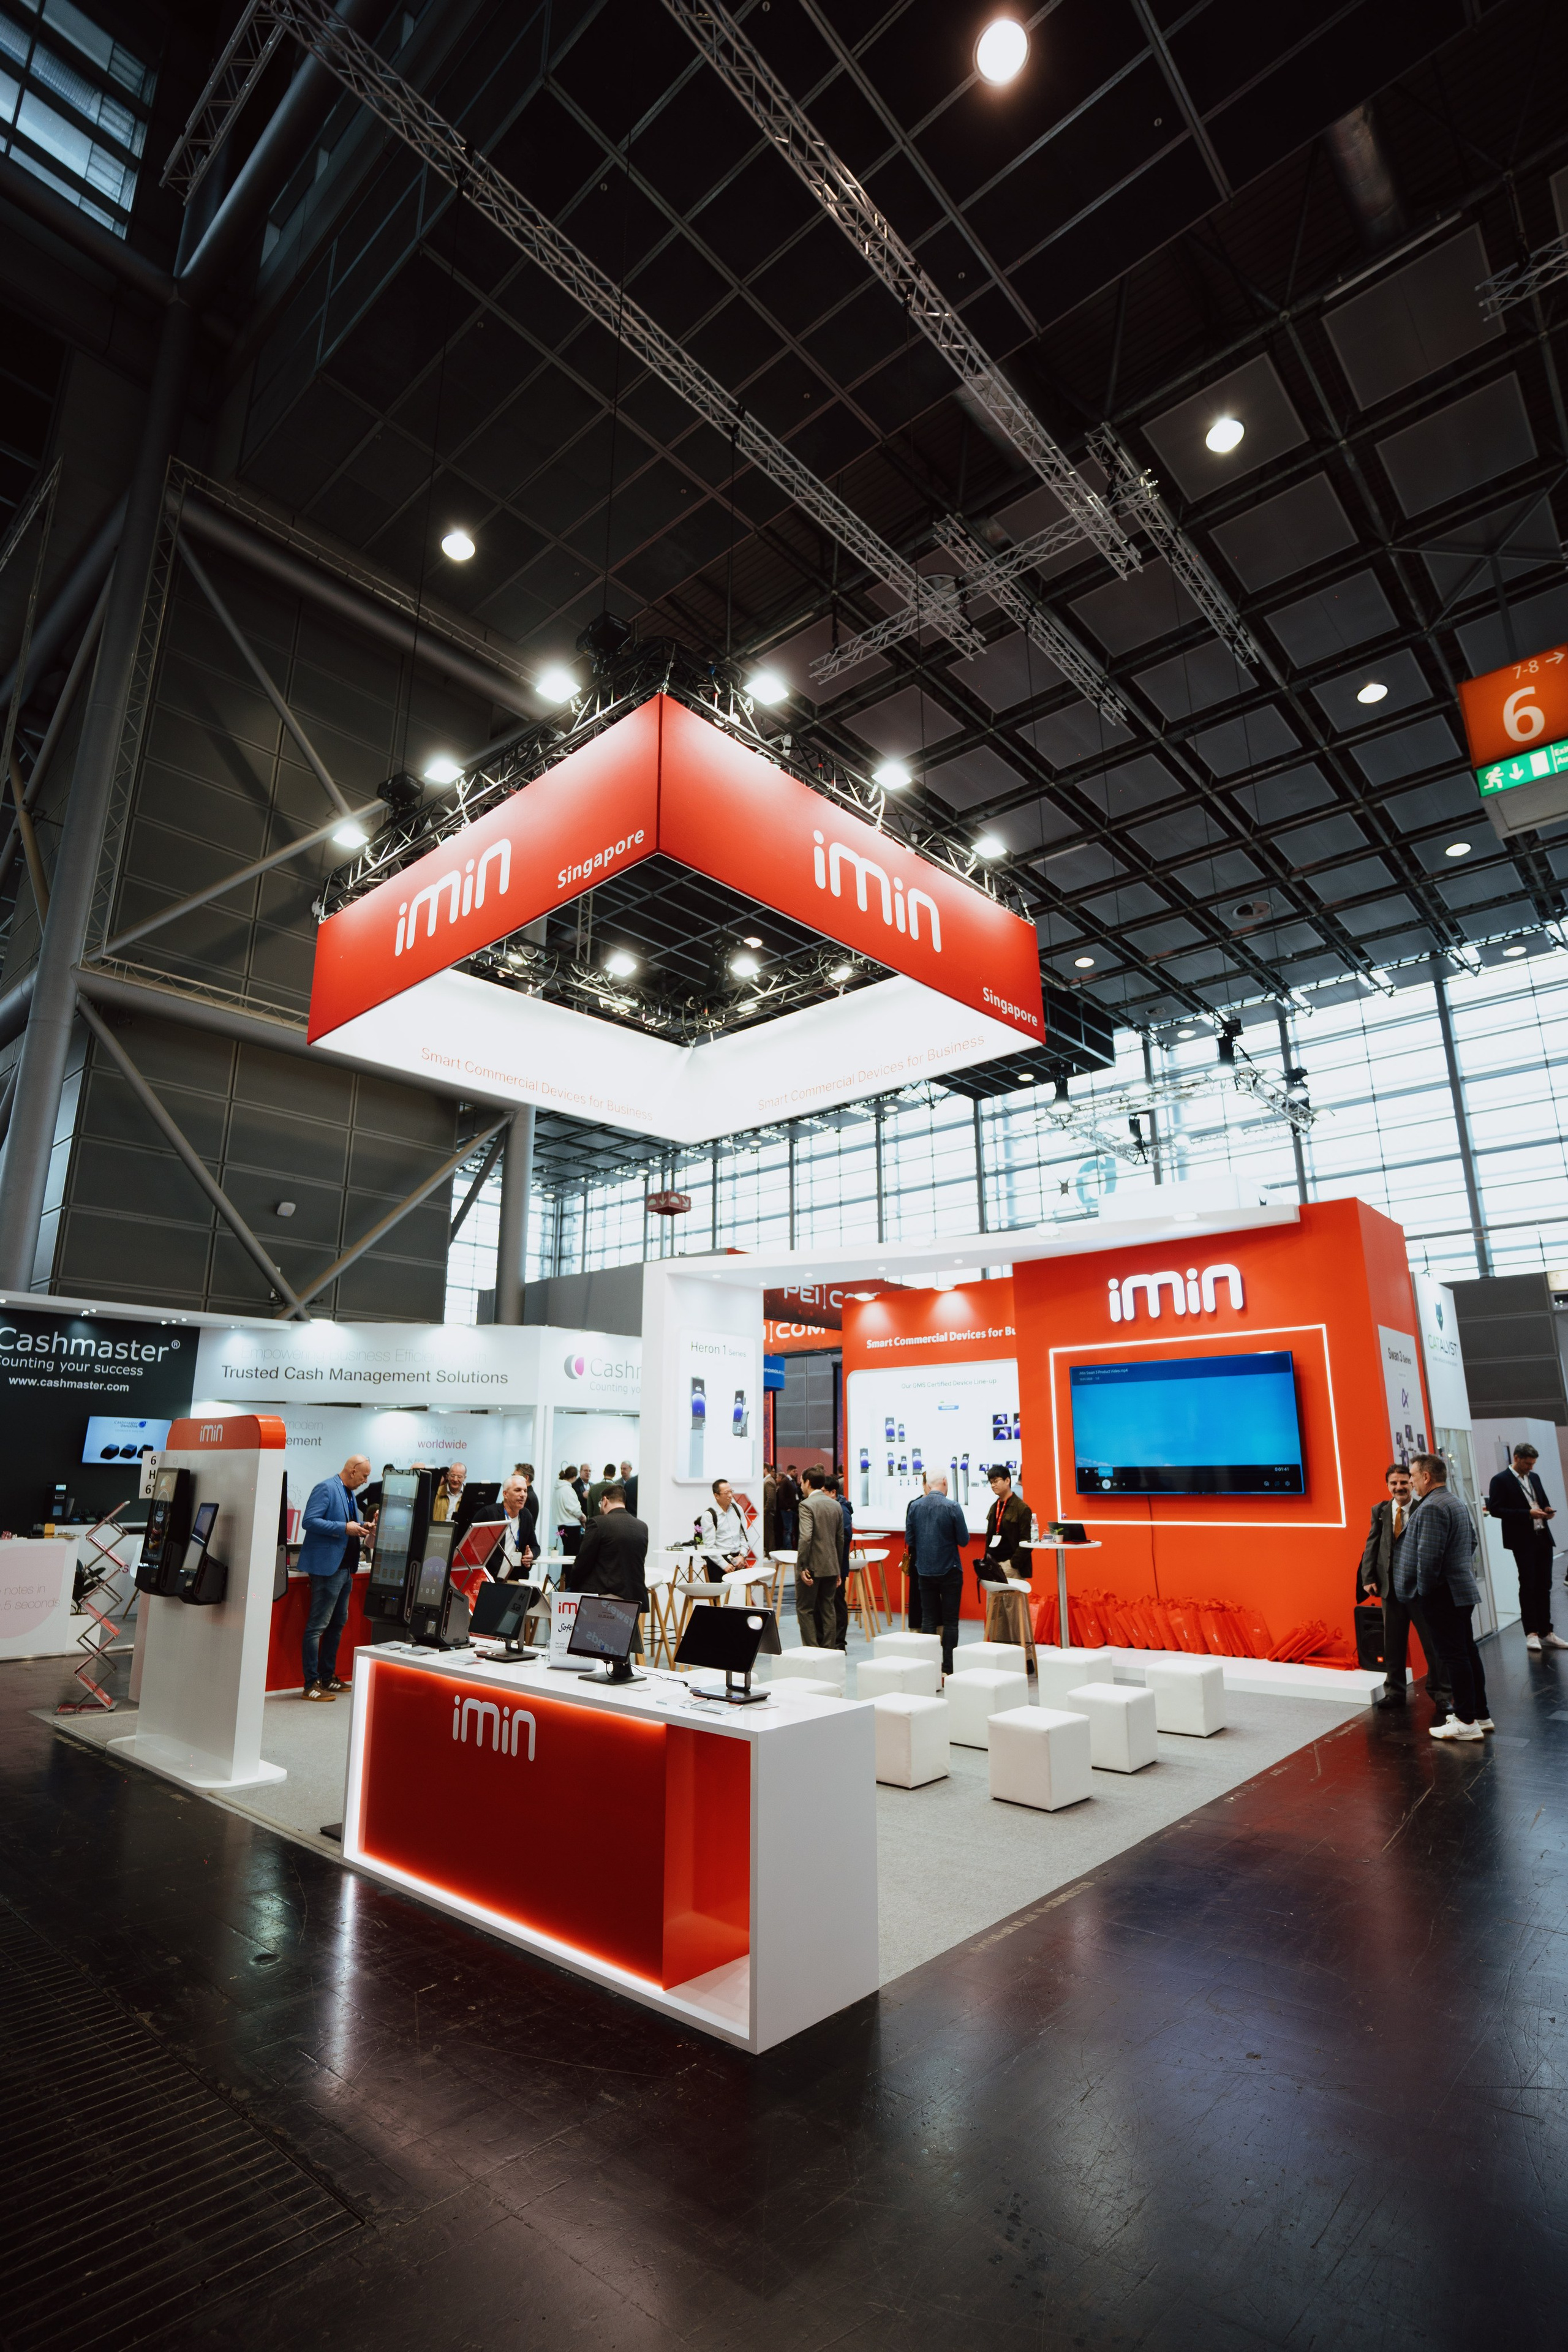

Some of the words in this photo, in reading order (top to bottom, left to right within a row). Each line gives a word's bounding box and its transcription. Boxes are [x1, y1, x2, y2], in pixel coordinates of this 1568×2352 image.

[1512, 660, 1539, 679] 7-8
[1502, 686, 1545, 742] 6
[1554, 745, 1568, 756] Exi
[557, 829, 645, 889] Singapore
[394, 838, 511, 957] imin
[813, 829, 942, 953] imin
[982, 986, 1038, 1027] Singapore
[758, 1094, 788, 1111] Smart
[790, 1074, 855, 1102] Commercial
[858, 1060, 905, 1084] Devices
[907, 1054, 924, 1068] for
[927, 1034, 985, 1062] Business
[421, 1047, 461, 1070] Smart
[465, 1060, 538, 1092] Commercial
[541, 1083, 586, 1105] Devices
[589, 1095, 605, 1109] for
[606, 1099, 654, 1121] Business
[1107, 1264, 1244, 1322] imin
[866, 1338, 893, 1349] Smart
[894, 1332, 948, 1346] Commercial
[949, 1329, 987, 1342] Devices
[987, 1327, 1003, 1338] for
[1428, 1334, 1458, 1357] CATALYST
[690, 1341, 720, 1355] Heron
[723, 1344, 726, 1355] 1
[728, 1349, 747, 1357] Series
[1387, 1347, 1400, 1361] Swan
[1399, 1351, 1403, 1362] 3
[0, 1355, 54, 1372] ounting
[60, 1361, 91, 1373] your
[94, 1363, 144, 1376] success
[221, 1365, 279, 1379] Trusted
[284, 1366, 323, 1380] Cash
[329, 1368, 431, 1384] Management
[436, 1370, 508, 1384] Solutions
[9, 1377, 130, 1392] www.cashmaster.com
[589, 1381, 628, 1395] Counting
[199, 1424, 224, 1442] imin
[286, 1436, 322, 1447] ement
[417, 1439, 467, 1449] worldwide
[150, 1455, 157, 1465] 6
[149, 1470, 156, 1479] H
[4, 1586, 34, 1596] notes
[37, 1584, 46, 1593] in
[15, 1597, 60, 1609] seconds
[557, 1623, 573, 1632] Soft
[452, 1695, 537, 1762] imin
